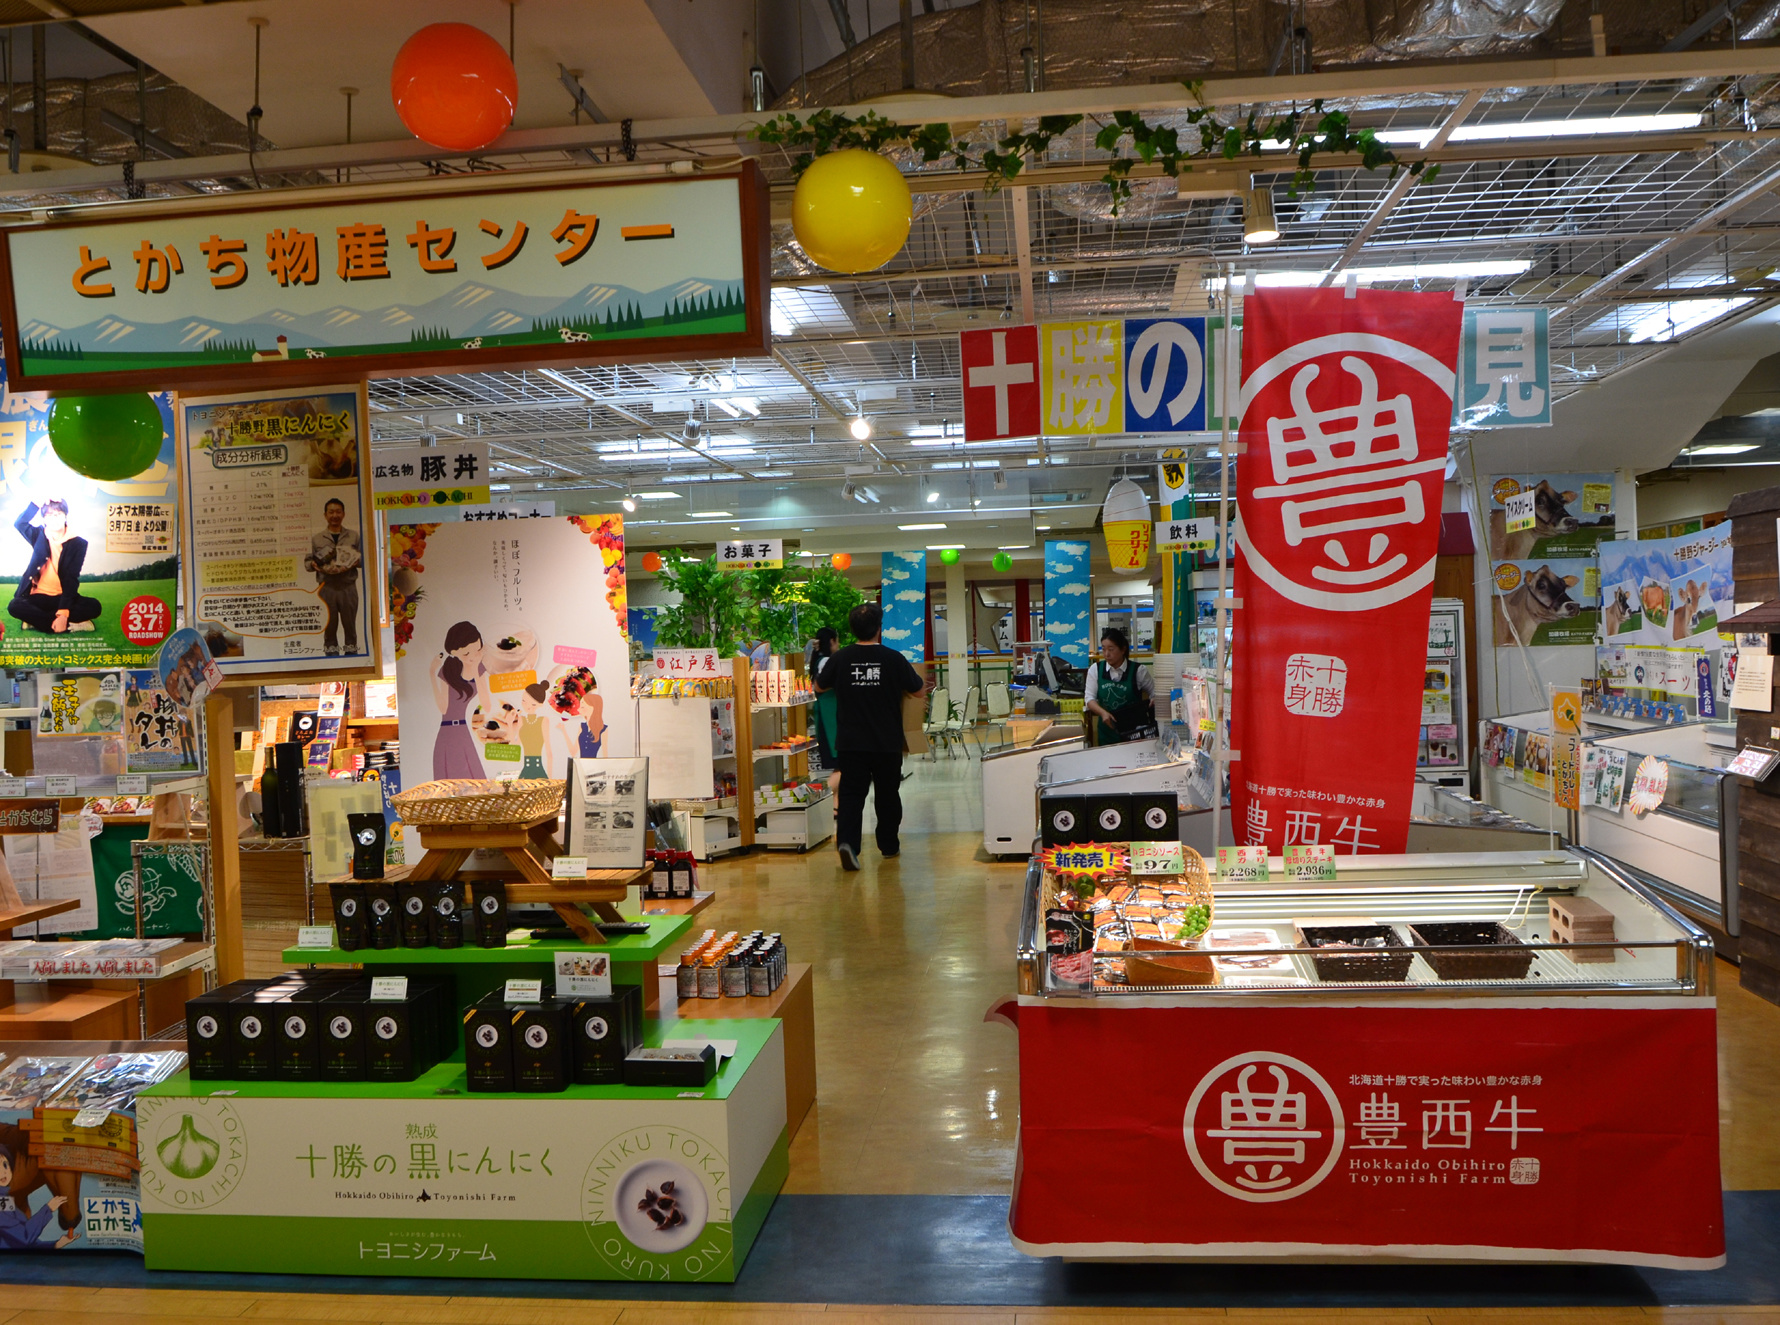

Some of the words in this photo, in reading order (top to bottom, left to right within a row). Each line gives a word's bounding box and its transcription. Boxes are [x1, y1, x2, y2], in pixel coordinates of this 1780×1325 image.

[72, 209, 674, 297] とかち物産センター
[968, 319, 1203, 436] 十勝の
[1466, 311, 1546, 419] 見
[192, 407, 262, 420] トヨニシファーム
[226, 410, 350, 437] 十勝野黒にんにく
[216, 448, 283, 464] 成分分析結果
[420, 453, 478, 483] 豚丼
[1252, 355, 1448, 586] 豊
[109, 505, 170, 517] シネマ太陽帯広にて
[1506, 496, 1533, 519] アイスクリーム
[1169, 524, 1198, 540] 飲料
[724, 543, 771, 559] お菓子
[1128, 530, 1141, 566] クリーム
[128, 603, 164, 614] 2014
[128, 614, 158, 631] 3.7
[670, 654, 716, 672] 江戸屋
[51, 685, 67, 733] ご飯のたれ
[61, 678, 80, 726] 玉子がけ
[135, 711, 158, 749] タレ
[1244, 798, 1381, 855] 豊西牛
[1133, 846, 1180, 856] トヨニシソース
[1219, 848, 1265, 857] 豊西牛
[1292, 847, 1326, 856] 豊西牛
[1055, 851, 1115, 869] 新発売！
[1229, 867, 1265, 877] 2,268円
[1296, 865, 1332, 876] 2,936円
[31, 960, 91, 975] 入荷しました
[93, 960, 154, 975] 入荷しました
[1349, 1074, 1543, 1087] 北海道十勝で実った味わい豊かな赤身
[1349, 1091, 1544, 1151] 豊西牛
[405, 1122, 438, 1139] 熟成
[296, 1142, 553, 1181] 十勝の黒にんにく
[1349, 1158, 1430, 1171] Hokkaido
[1438, 1158, 1505, 1171] Obihiro
[588, 1132, 651, 1227] NINNIKU
[666, 1132, 732, 1234] TOKACHI
[1349, 1172, 1447, 1186] Toyonishi
[1459, 1173, 1506, 1185] Farm
[174, 1189, 205, 1204] NO
[335, 1190, 377, 1200] Hokkaido
[379, 1191, 414, 1200] Obihiro
[433, 1192, 486, 1202] Toyonishi
[491, 1193, 516, 1202] Farm
[87, 1199, 131, 1215] とかち
[87, 1215, 132, 1232] のかち
[359, 1241, 497, 1262] トヨニシファーム
[603, 1238, 671, 1281] KURO
[684, 1240, 722, 1275] NO
